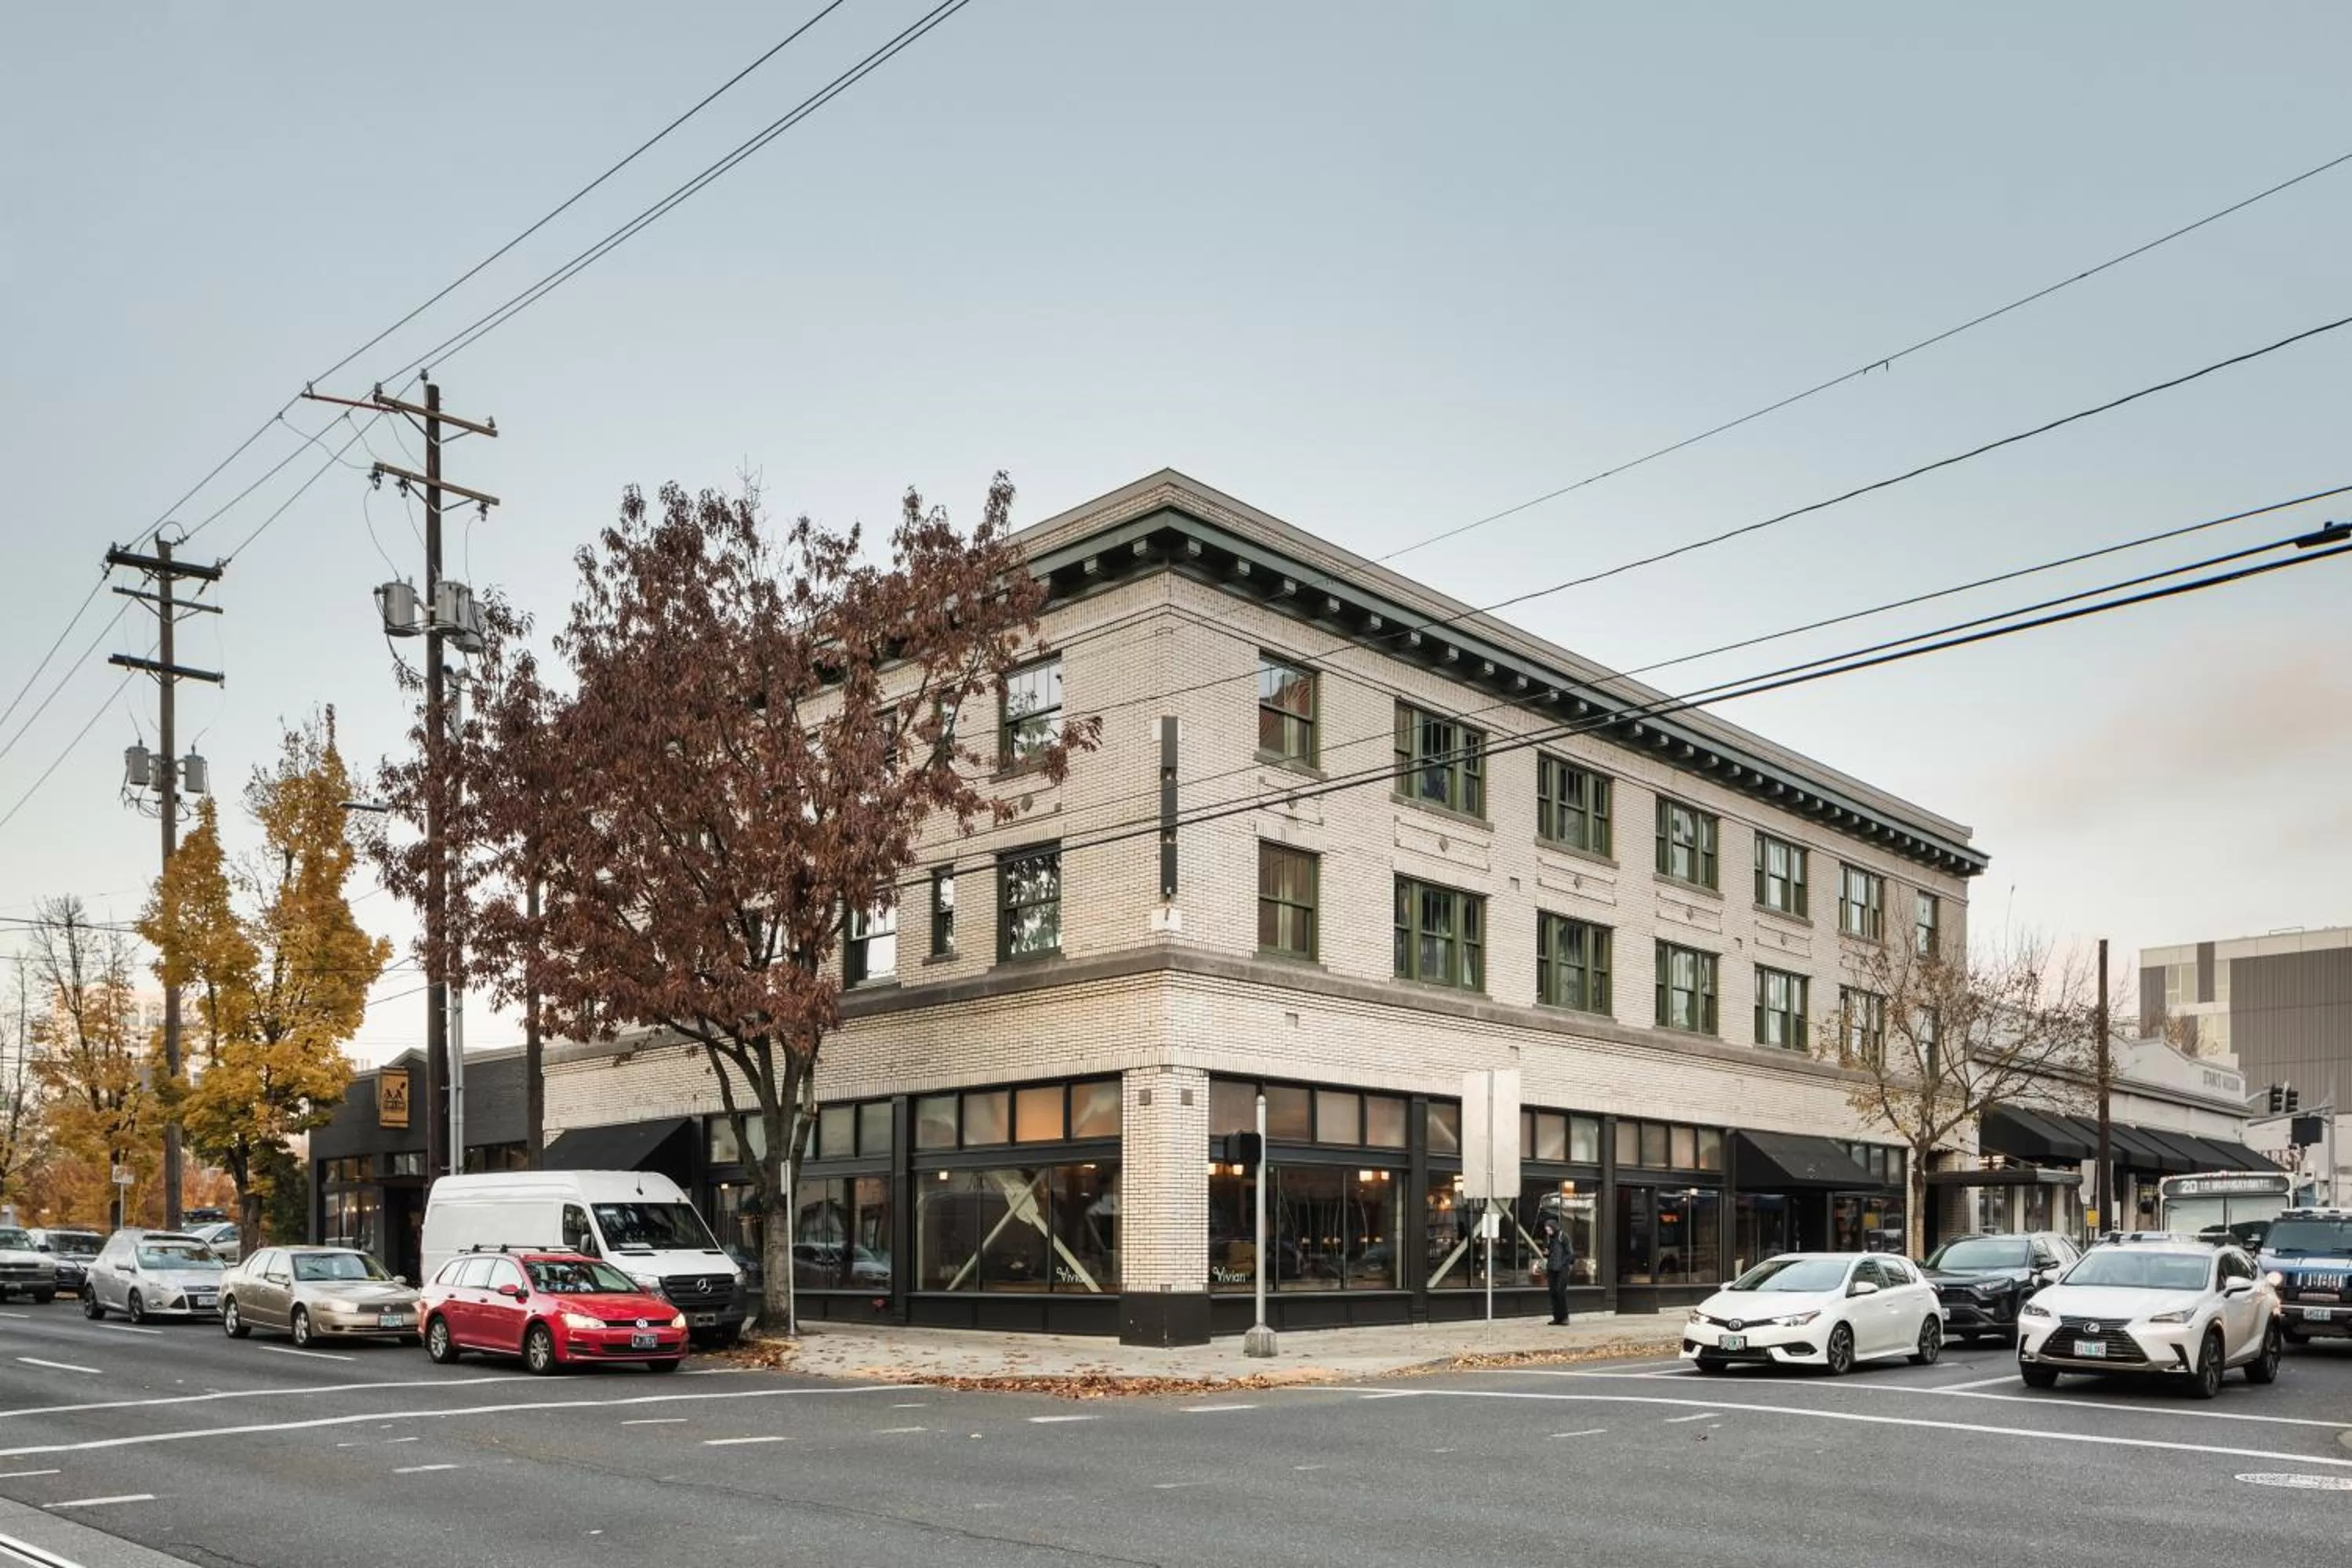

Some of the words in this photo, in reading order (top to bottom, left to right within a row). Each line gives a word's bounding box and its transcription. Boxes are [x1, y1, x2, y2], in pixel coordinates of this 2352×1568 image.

[2181, 1181, 2198, 1193] 20
[1056, 1266, 1086, 1283] Vivi
[1211, 1266, 1246, 1283] Vivian
